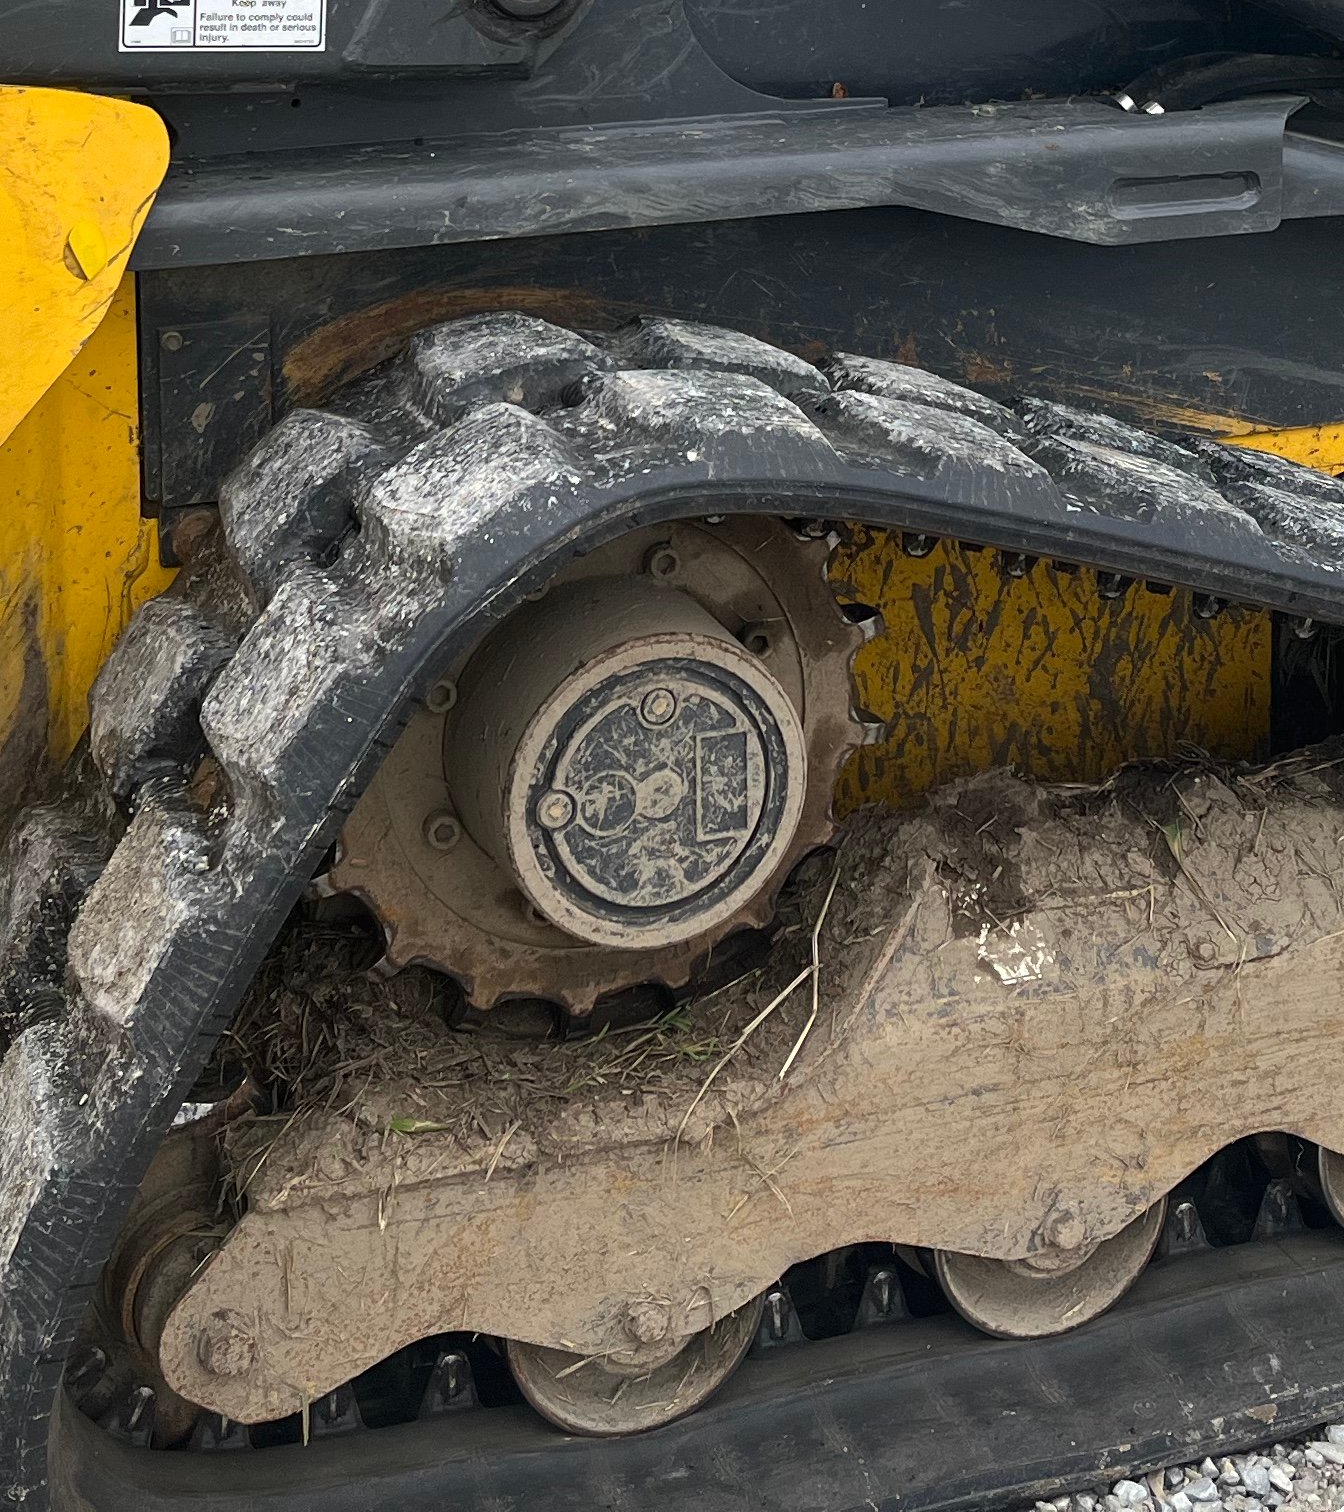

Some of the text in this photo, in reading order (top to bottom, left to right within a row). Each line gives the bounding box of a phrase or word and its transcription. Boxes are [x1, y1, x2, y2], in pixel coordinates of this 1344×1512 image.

[232, 0, 256, 8] Keep
[200, 13, 233, 21] Failure
[248, 14, 283, 23] comply
[200, 23, 227, 31] result
[229, 23, 238, 31] in
[241, 23, 267, 32] death
[282, 23, 316, 31] serious
[199, 34, 229, 42] injury.
